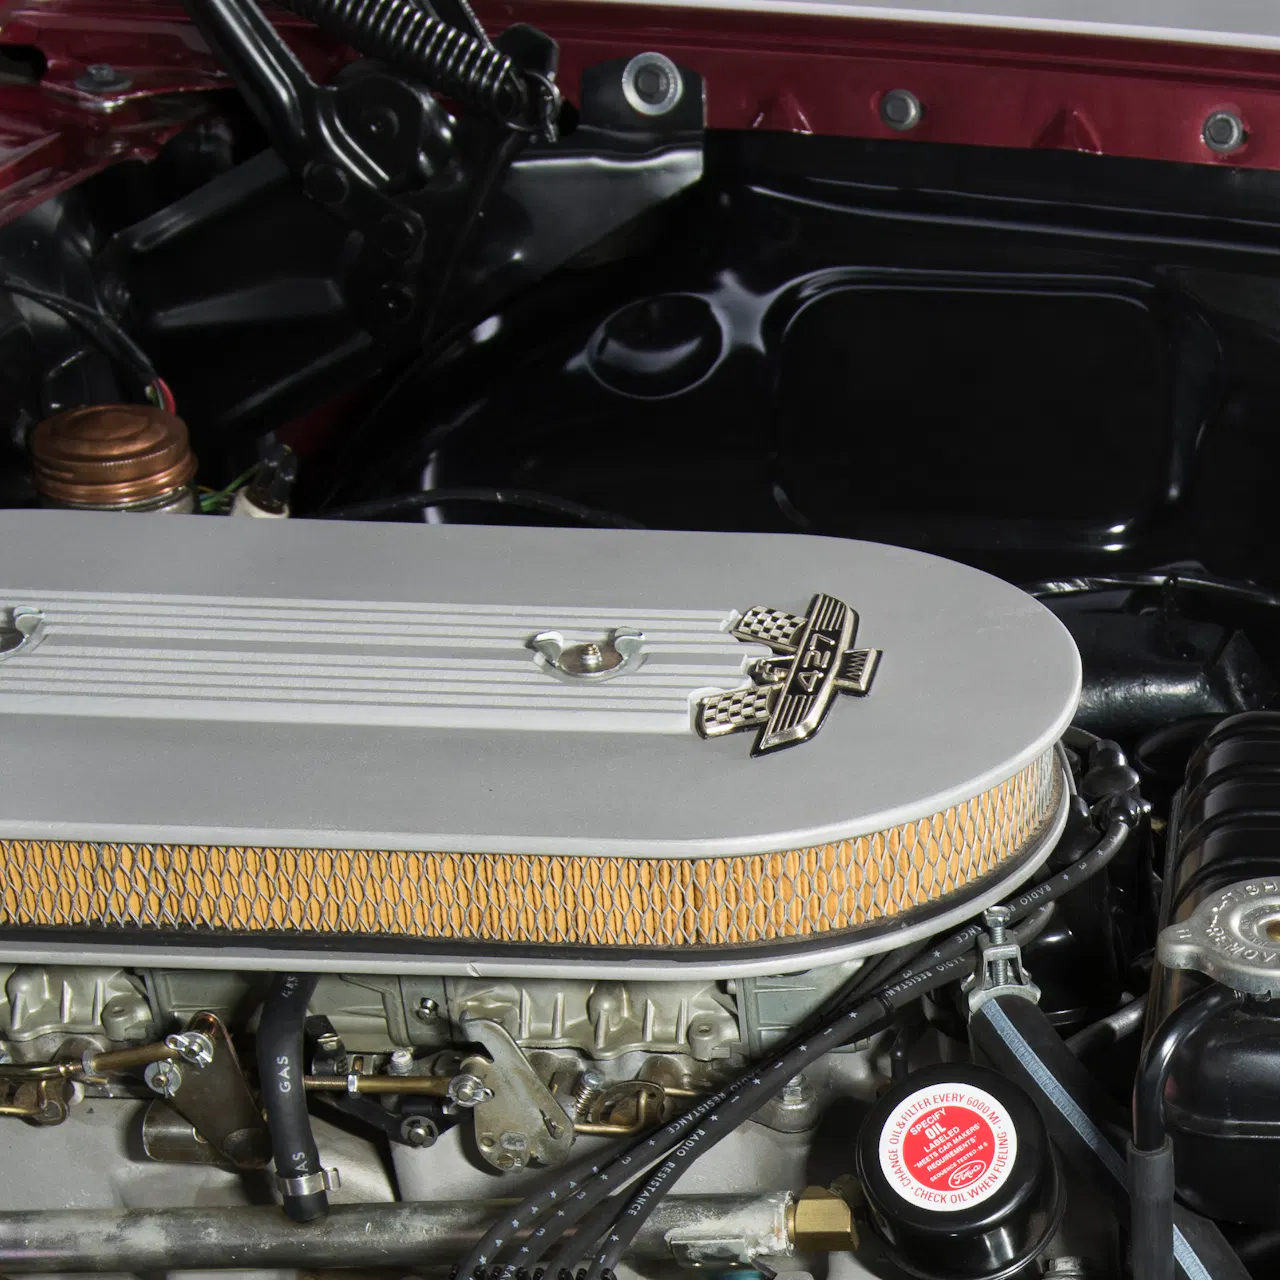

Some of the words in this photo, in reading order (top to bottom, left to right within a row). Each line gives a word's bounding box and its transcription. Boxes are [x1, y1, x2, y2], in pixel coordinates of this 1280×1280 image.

[797, 633, 837, 693] 427
[1019, 884, 1052, 906] RADIO
[276, 1055, 292, 1093] GAS
[667, 1091, 727, 1134] RESISTANCE
[909, 1107, 947, 1136] SPECIFY
[675, 1128, 707, 1158] RADIO
[887, 1148, 912, 1188] CHANGE
[932, 1092, 966, 1105] EVERY
[923, 1126, 961, 1153] LABELED
[924, 1122, 947, 1140] OIL
[937, 1141, 954, 1154] CAR
[291, 1151, 309, 1179] AS
[913, 1186, 948, 1205] CHECK
[949, 1193, 969, 1205] OIL
[967, 1173, 999, 1200] WHEN
[993, 1131, 1010, 1175] FUELING
[626, 1160, 677, 1217] RESISTANCE
